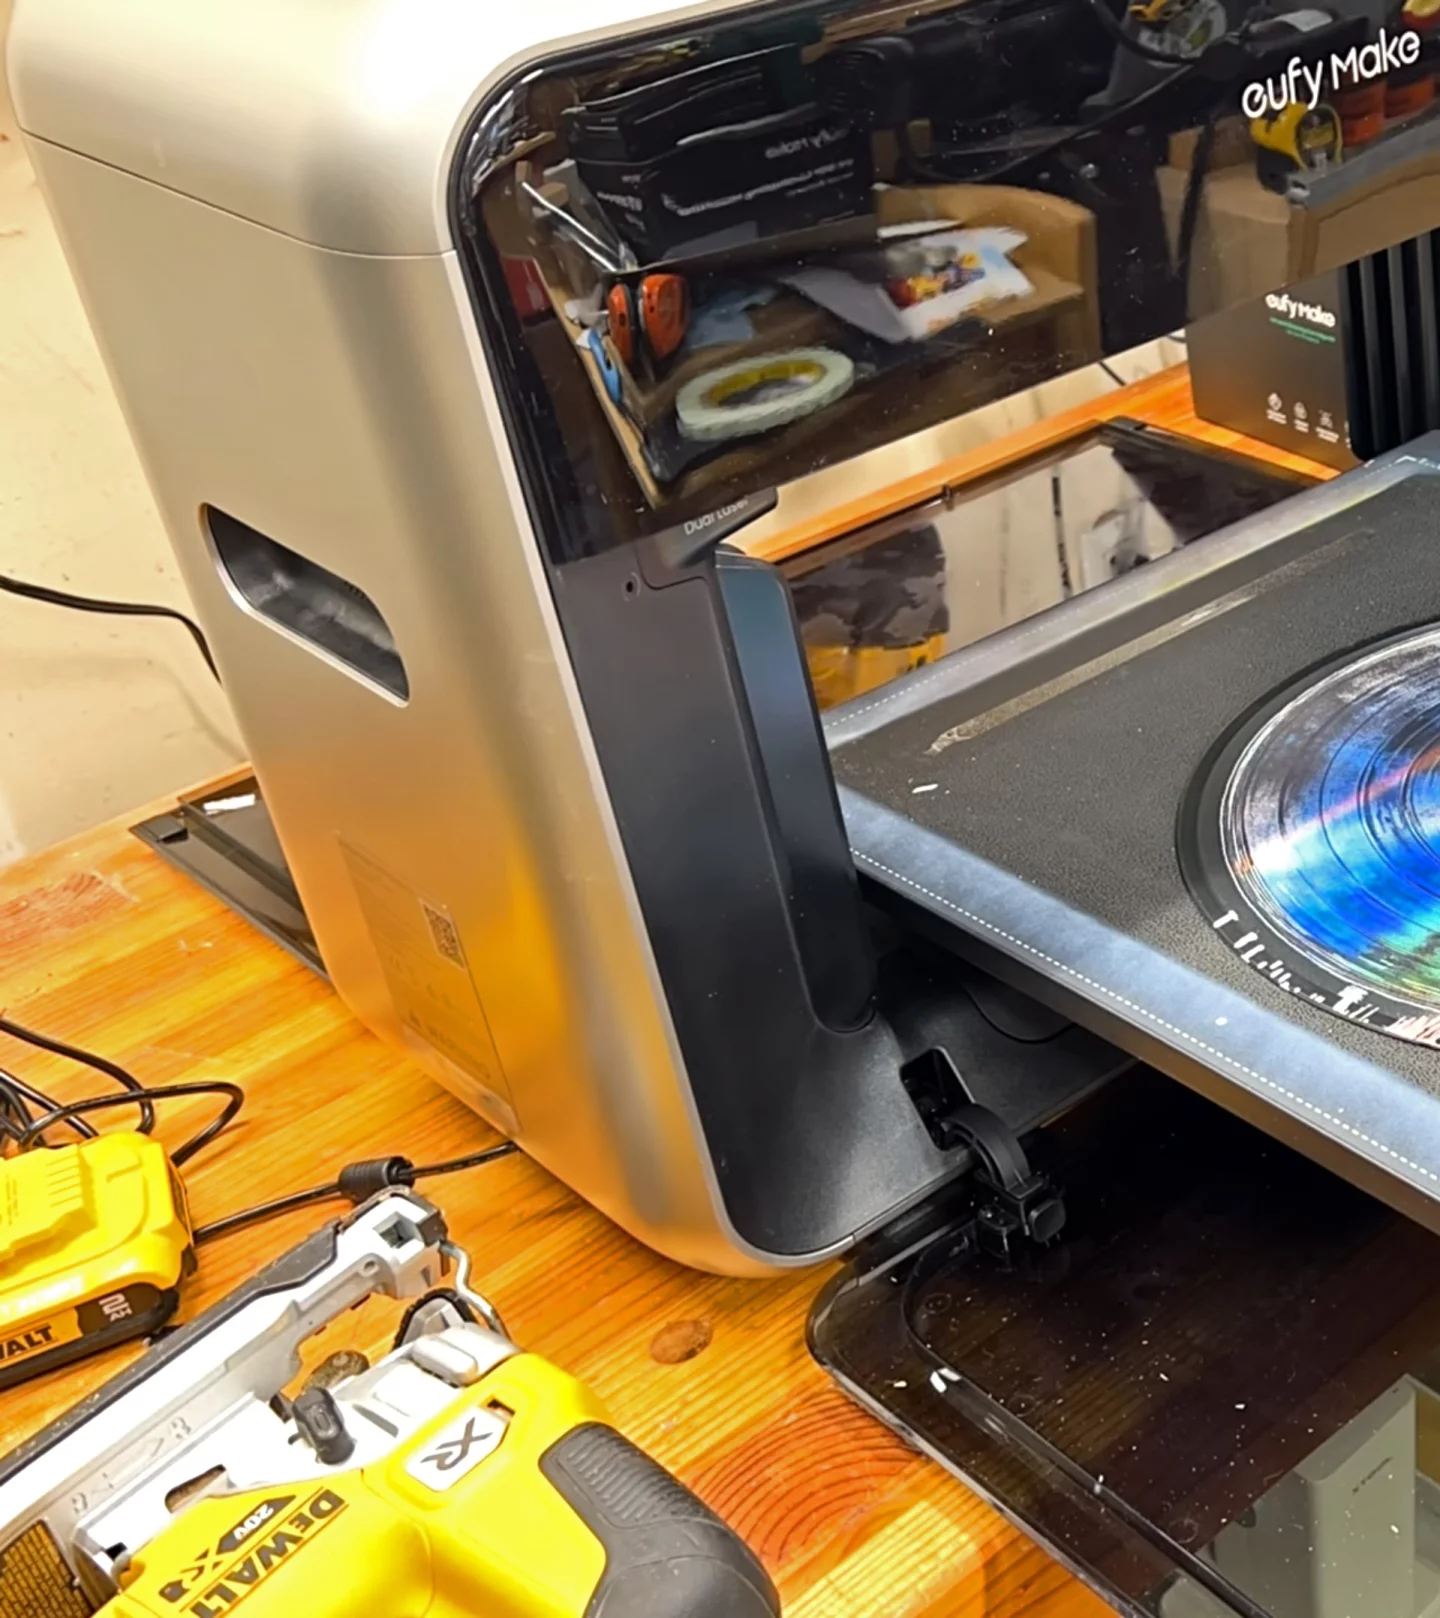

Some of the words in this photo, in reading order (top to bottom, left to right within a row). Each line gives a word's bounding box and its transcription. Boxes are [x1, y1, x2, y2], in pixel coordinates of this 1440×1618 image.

[0, 1323, 54, 1360] ALT
[420, 1416, 494, 1471] XR
[233, 1503, 276, 1541] 20V
[190, 1487, 346, 1618] DEWALT
